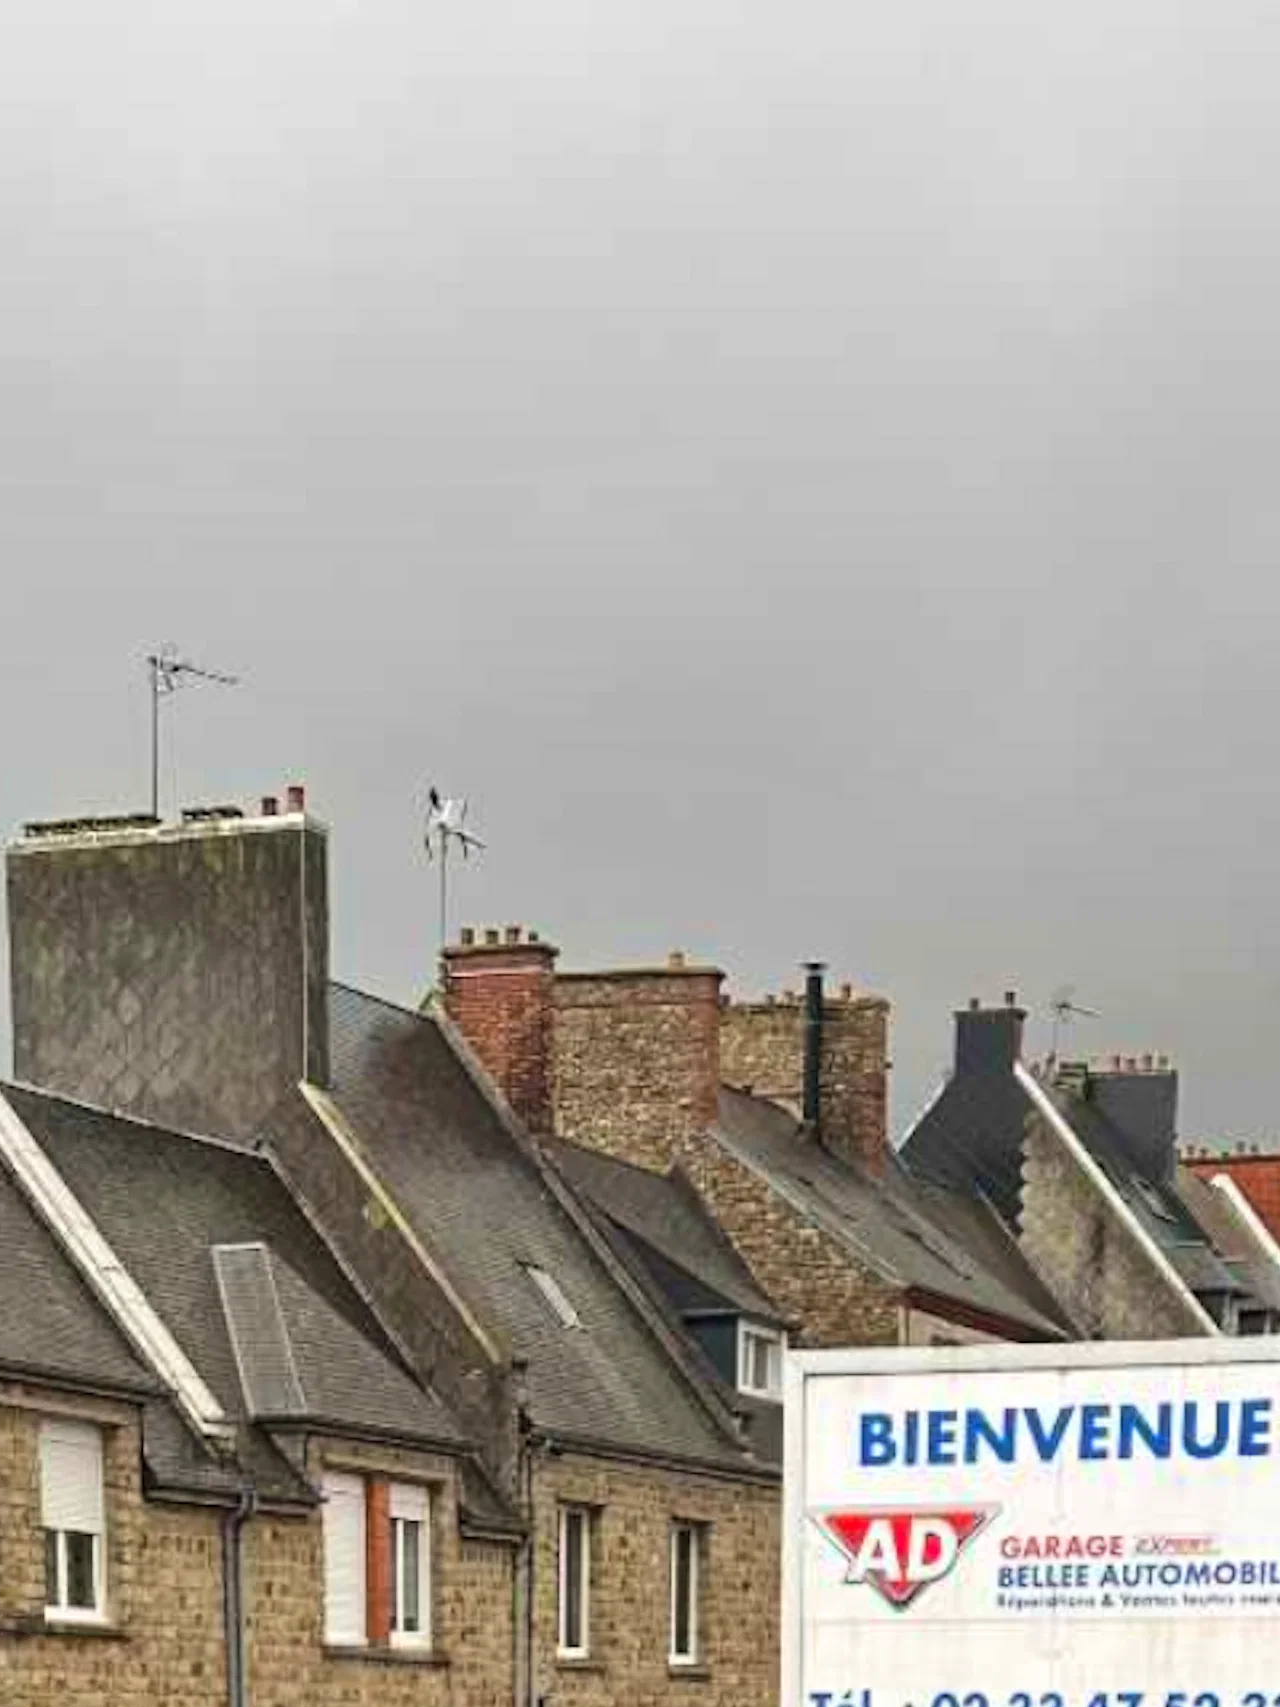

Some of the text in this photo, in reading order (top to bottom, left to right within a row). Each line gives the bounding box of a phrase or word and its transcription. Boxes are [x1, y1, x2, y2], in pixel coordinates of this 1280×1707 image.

[859, 1398, 1273, 1467] BIENVENUE
[845, 1516, 960, 1583] AD
[999, 1536, 1124, 1559] GARAGE
[997, 1564, 1089, 1588] BELLEE
